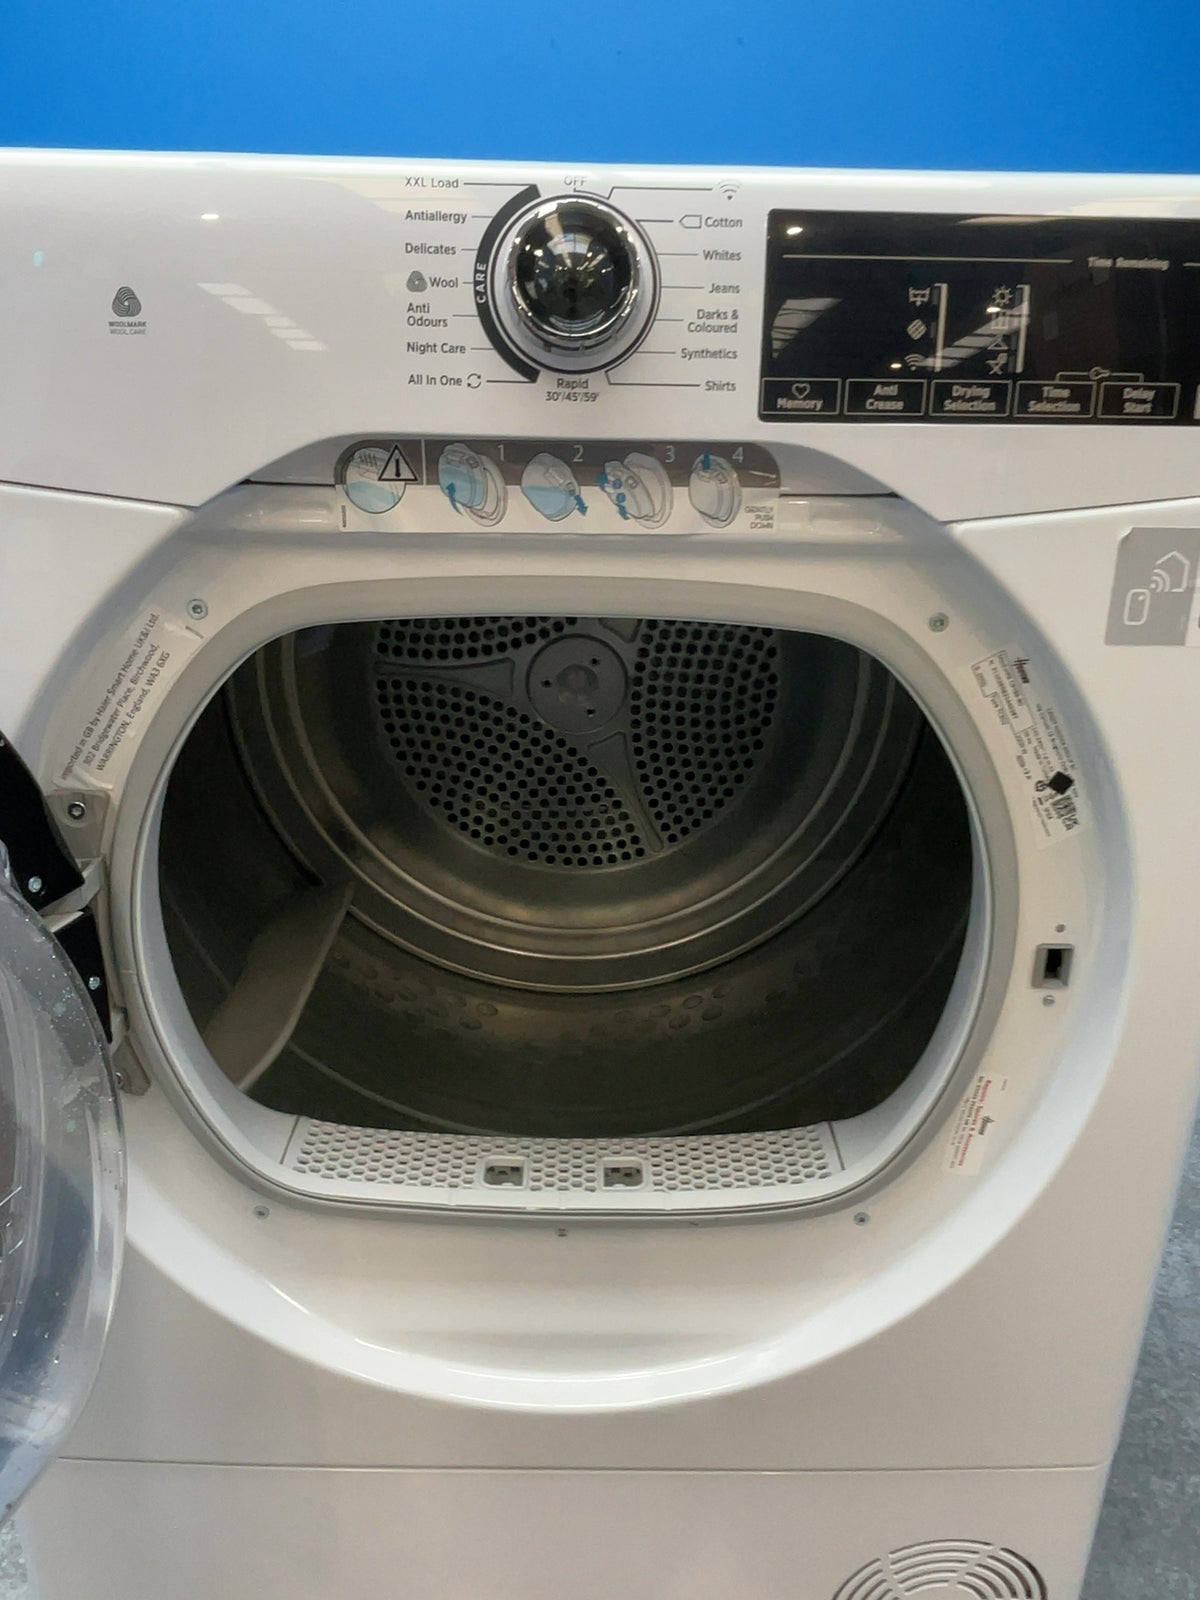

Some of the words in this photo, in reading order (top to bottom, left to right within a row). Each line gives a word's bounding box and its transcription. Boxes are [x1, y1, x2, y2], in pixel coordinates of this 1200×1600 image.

[405, 177, 427, 188] XXL
[431, 178, 459, 189] Load
[563, 175, 588, 186] OFF
[405, 210, 467, 224] Antiallergy
[704, 217, 743, 228] Cotton
[405, 242, 456, 255] Delicates
[703, 249, 742, 261] Whites
[429, 276, 458, 288] Wool
[475, 262, 487, 304] CARE
[708, 282, 741, 294] Jeans
[406, 302, 430, 314] Anti
[696, 309, 728, 320] Darks
[731, 309, 739, 320] &
[406, 315, 448, 327] Odours
[687, 322, 738, 334] Coloured
[406, 342, 437, 354] Night
[440, 342, 466, 354] Care
[680, 347, 738, 361] Synthetics
[407, 374, 423, 386] All
[426, 375, 437, 386] In
[440, 375, 463, 386] One
[556, 378, 590, 390] Rapid
[705, 381, 737, 392] Shirts
[497, 445, 505, 460] 1
[572, 445, 584, 462] 2
[664, 446, 676, 463] 3
[731, 447, 744, 463] 4
[83, 725, 94, 739] GB
[89, 715, 101, 727] by
[107, 672, 126, 696] Smart
[122, 649, 139, 673] Home
[148, 613, 160, 629] Ltd.
[96, 720, 132, 771] WARRINGTON,
[126, 689, 150, 720] England,
[146, 667, 160, 687] WA3
[91, 706, 120, 753] Bridgewater
